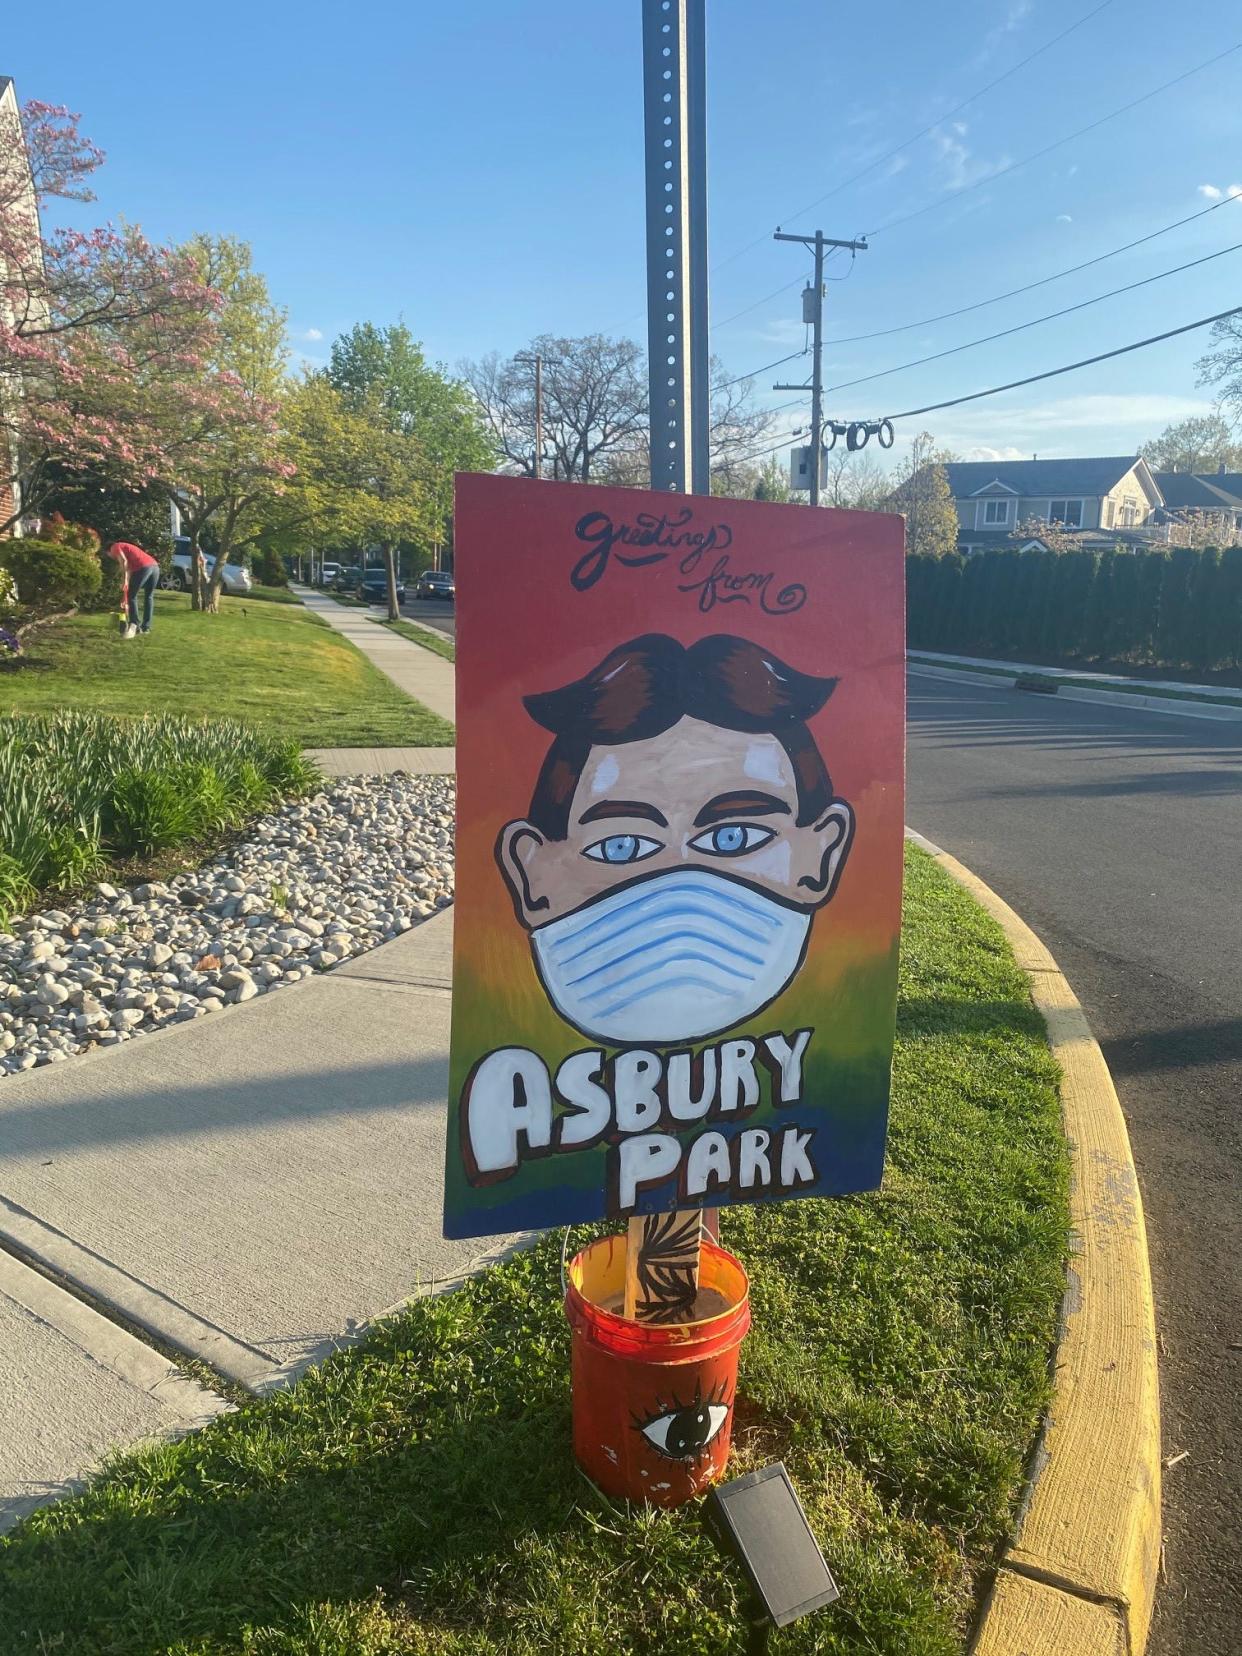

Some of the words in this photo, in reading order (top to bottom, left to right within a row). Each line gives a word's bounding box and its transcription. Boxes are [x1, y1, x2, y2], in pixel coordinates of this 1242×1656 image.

[677, 555, 807, 615] from
[463, 1030, 812, 1180] ASBURY
[612, 1124, 817, 1212] PARK
